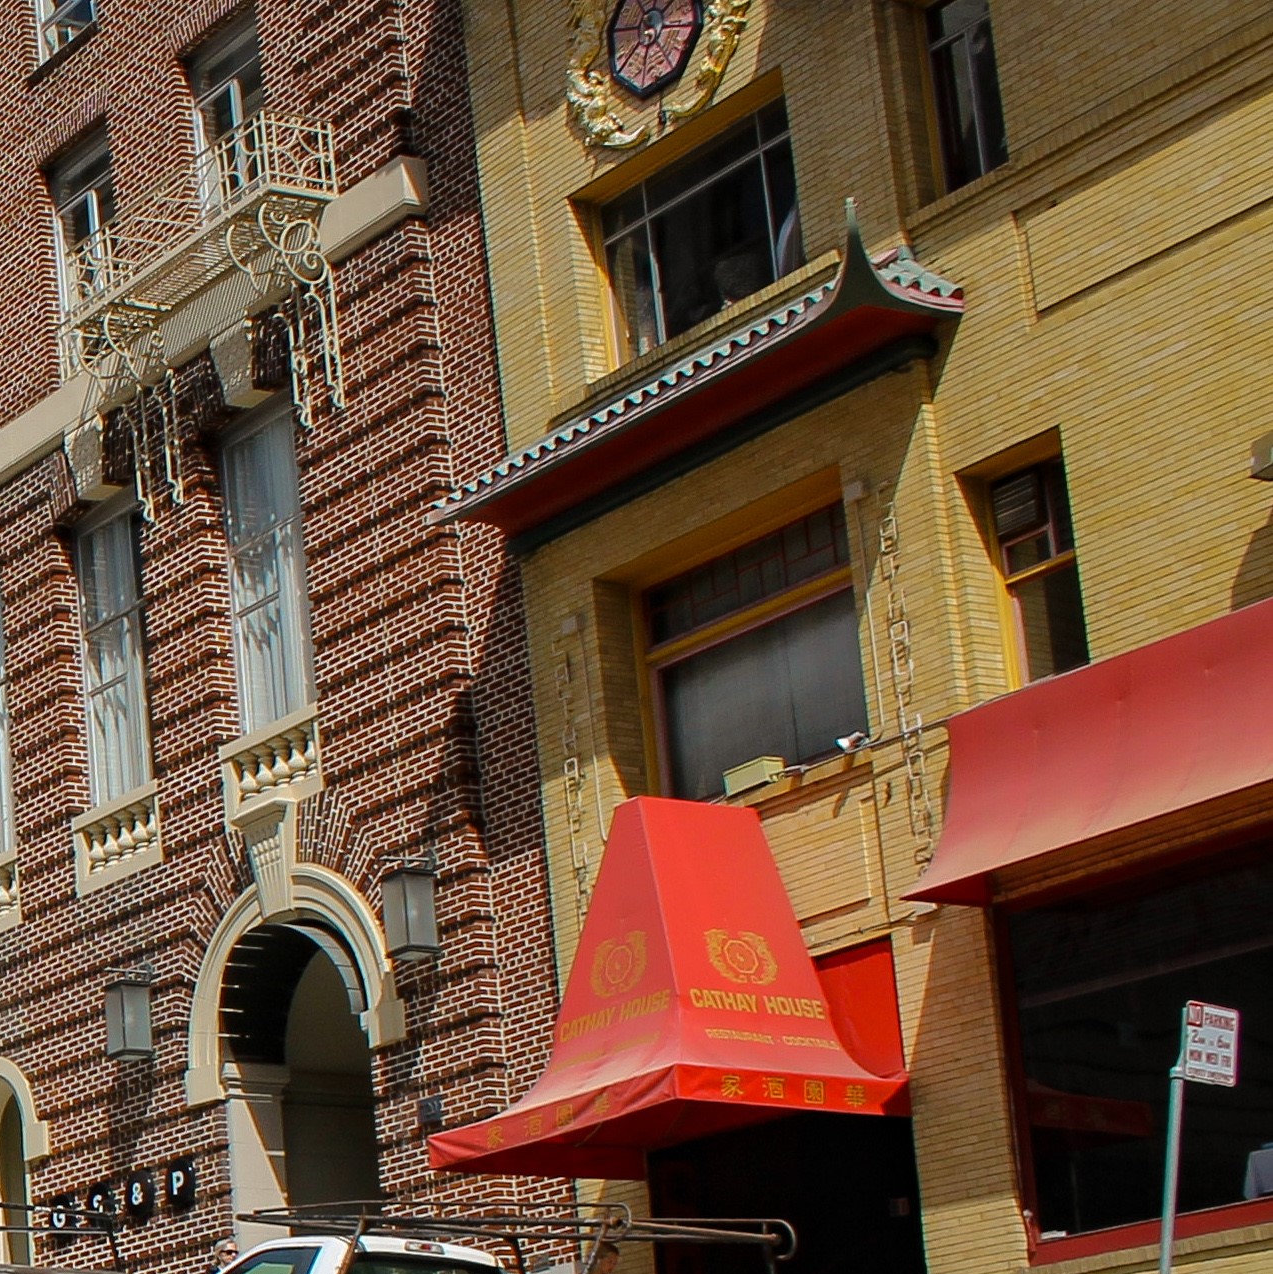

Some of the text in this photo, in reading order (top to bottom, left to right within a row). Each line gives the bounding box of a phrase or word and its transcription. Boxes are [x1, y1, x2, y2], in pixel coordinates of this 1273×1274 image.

[560, 989, 671, 1042] CATHAY HOUSE
[689, 988, 825, 1019] CATHAY HOUSE
